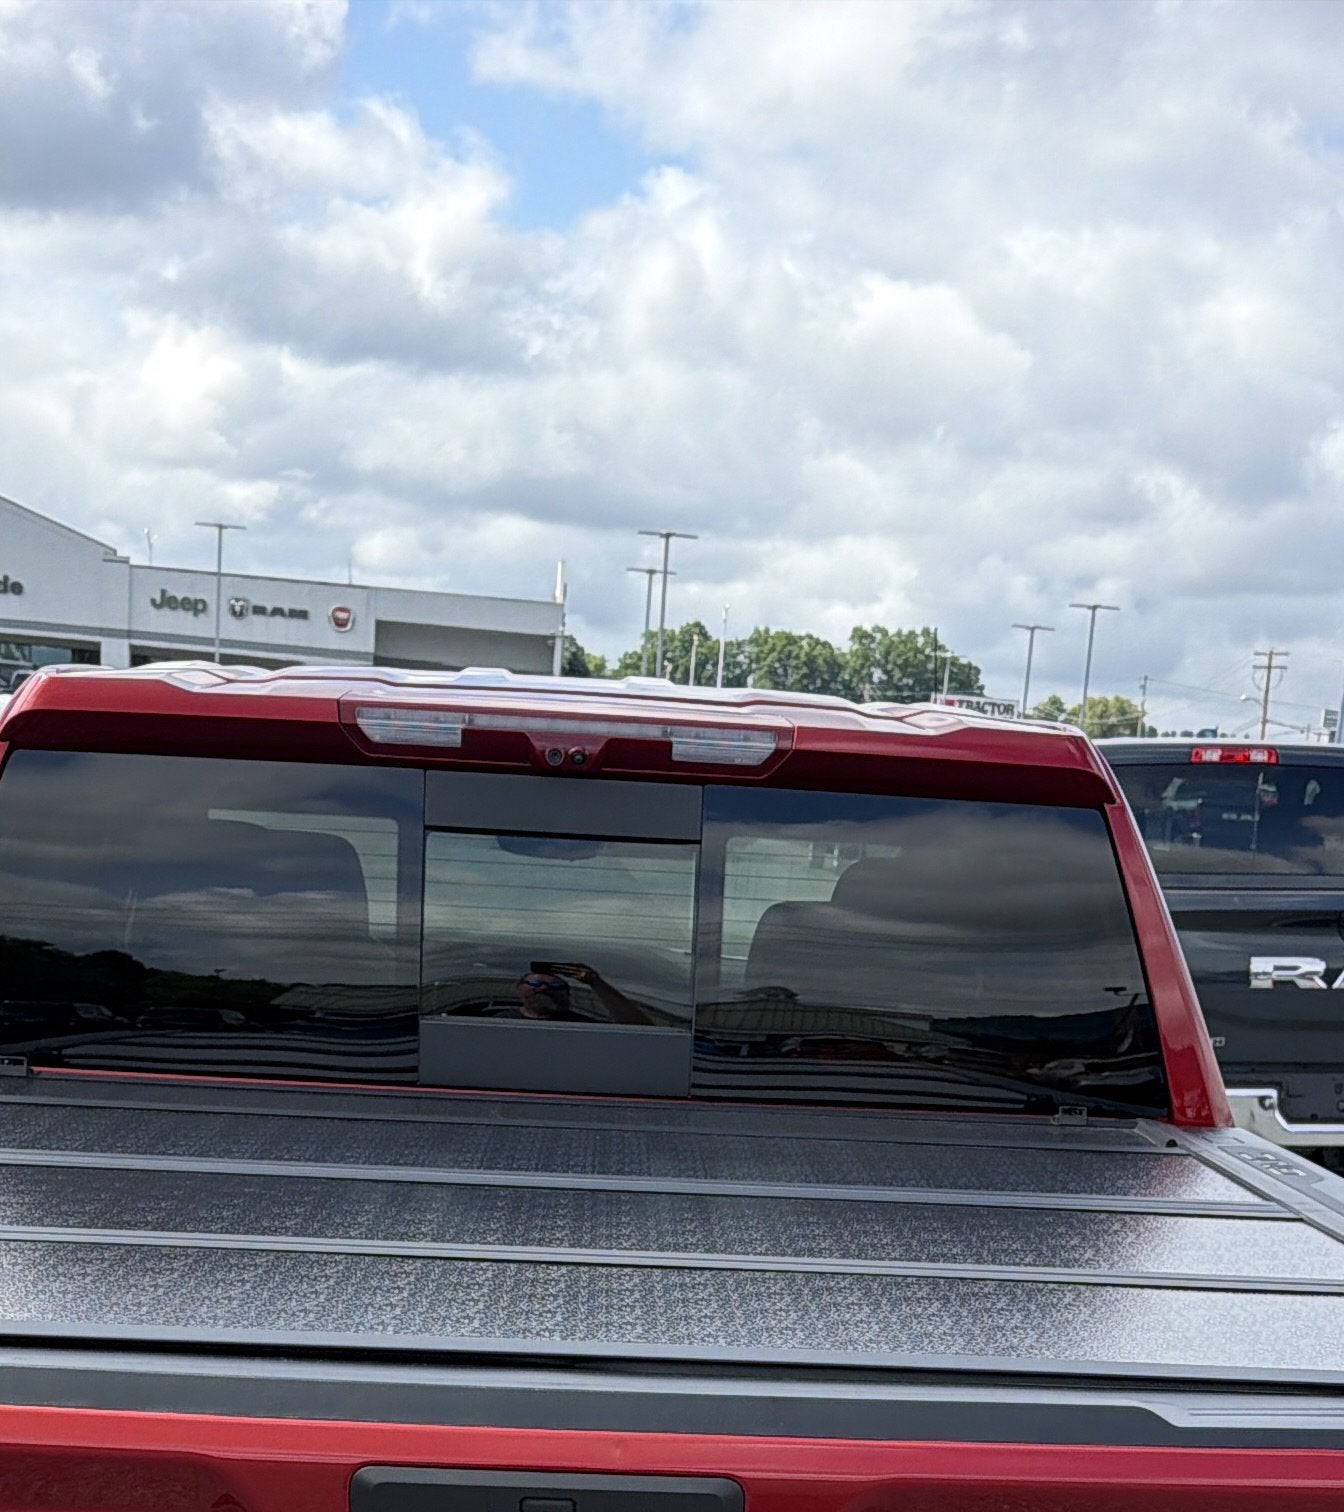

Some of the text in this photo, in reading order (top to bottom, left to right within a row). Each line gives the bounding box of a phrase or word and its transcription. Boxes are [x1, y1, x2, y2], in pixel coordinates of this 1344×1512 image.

[150, 588, 208, 617] Jeep
[252, 604, 309, 621] RAM
[958, 699, 1015, 716] TRACTOR
